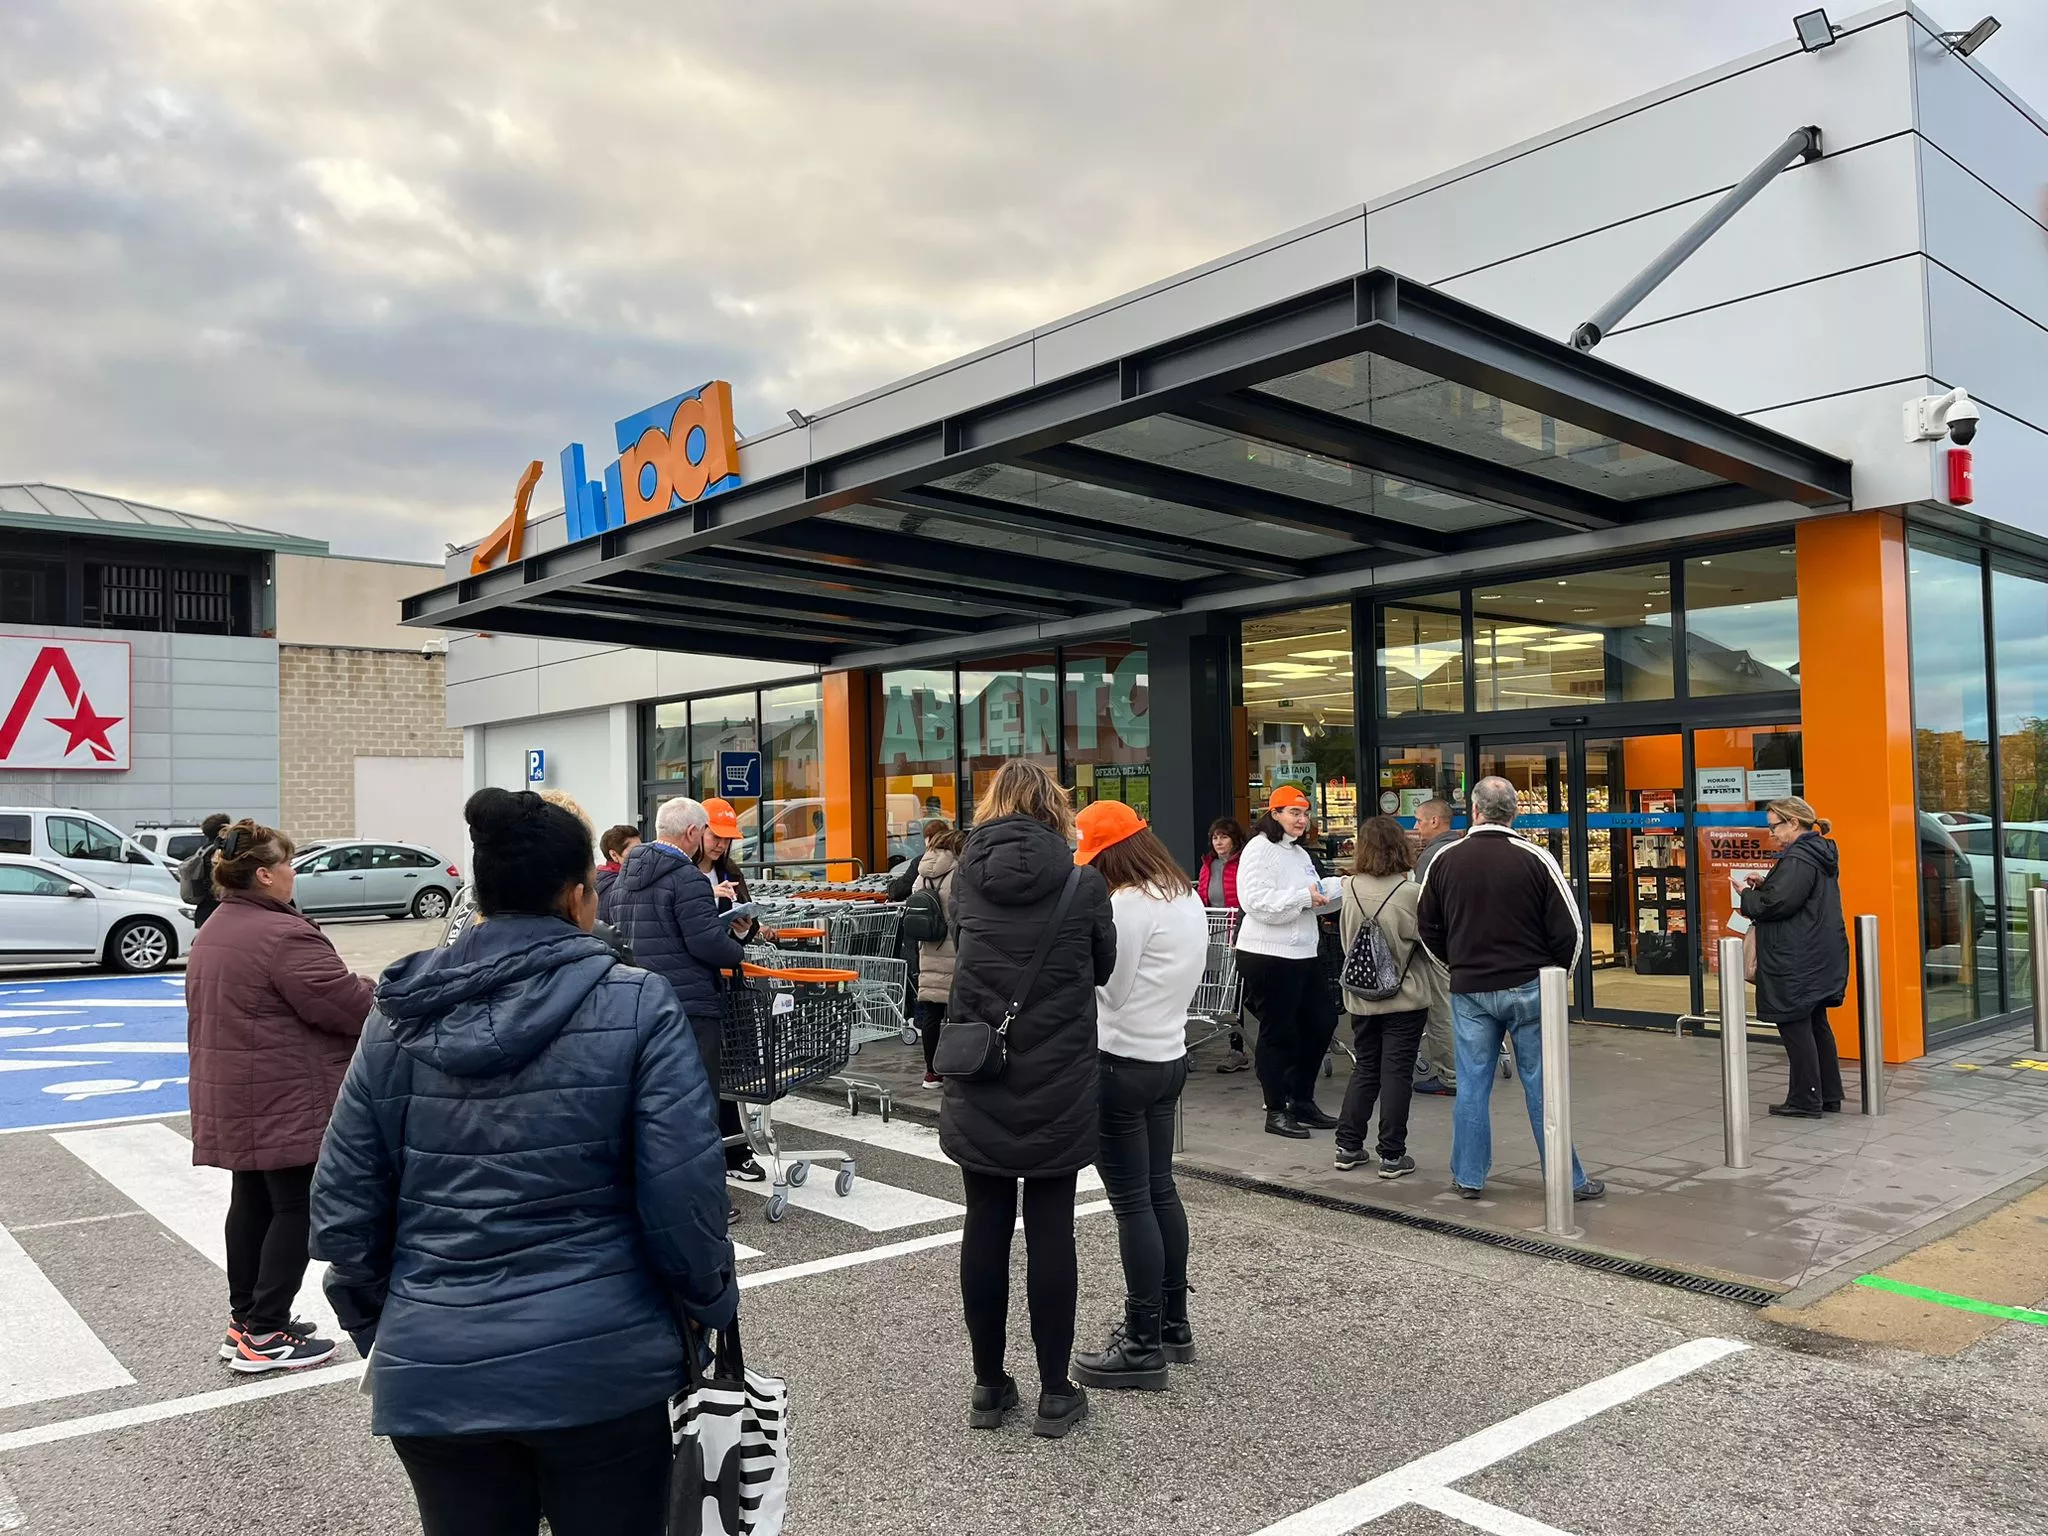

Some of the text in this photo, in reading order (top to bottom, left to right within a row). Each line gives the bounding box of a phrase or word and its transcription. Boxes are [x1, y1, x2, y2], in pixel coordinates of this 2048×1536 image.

[530, 752, 540, 776] P
[1095, 767, 1121, 777] OFERTA
[1122, 766, 1136, 775] DEL
[1710, 831, 1748, 839] Regalamos
[1711, 839, 1760, 849] VALES
[1711, 849, 1778, 860] DESCUE
